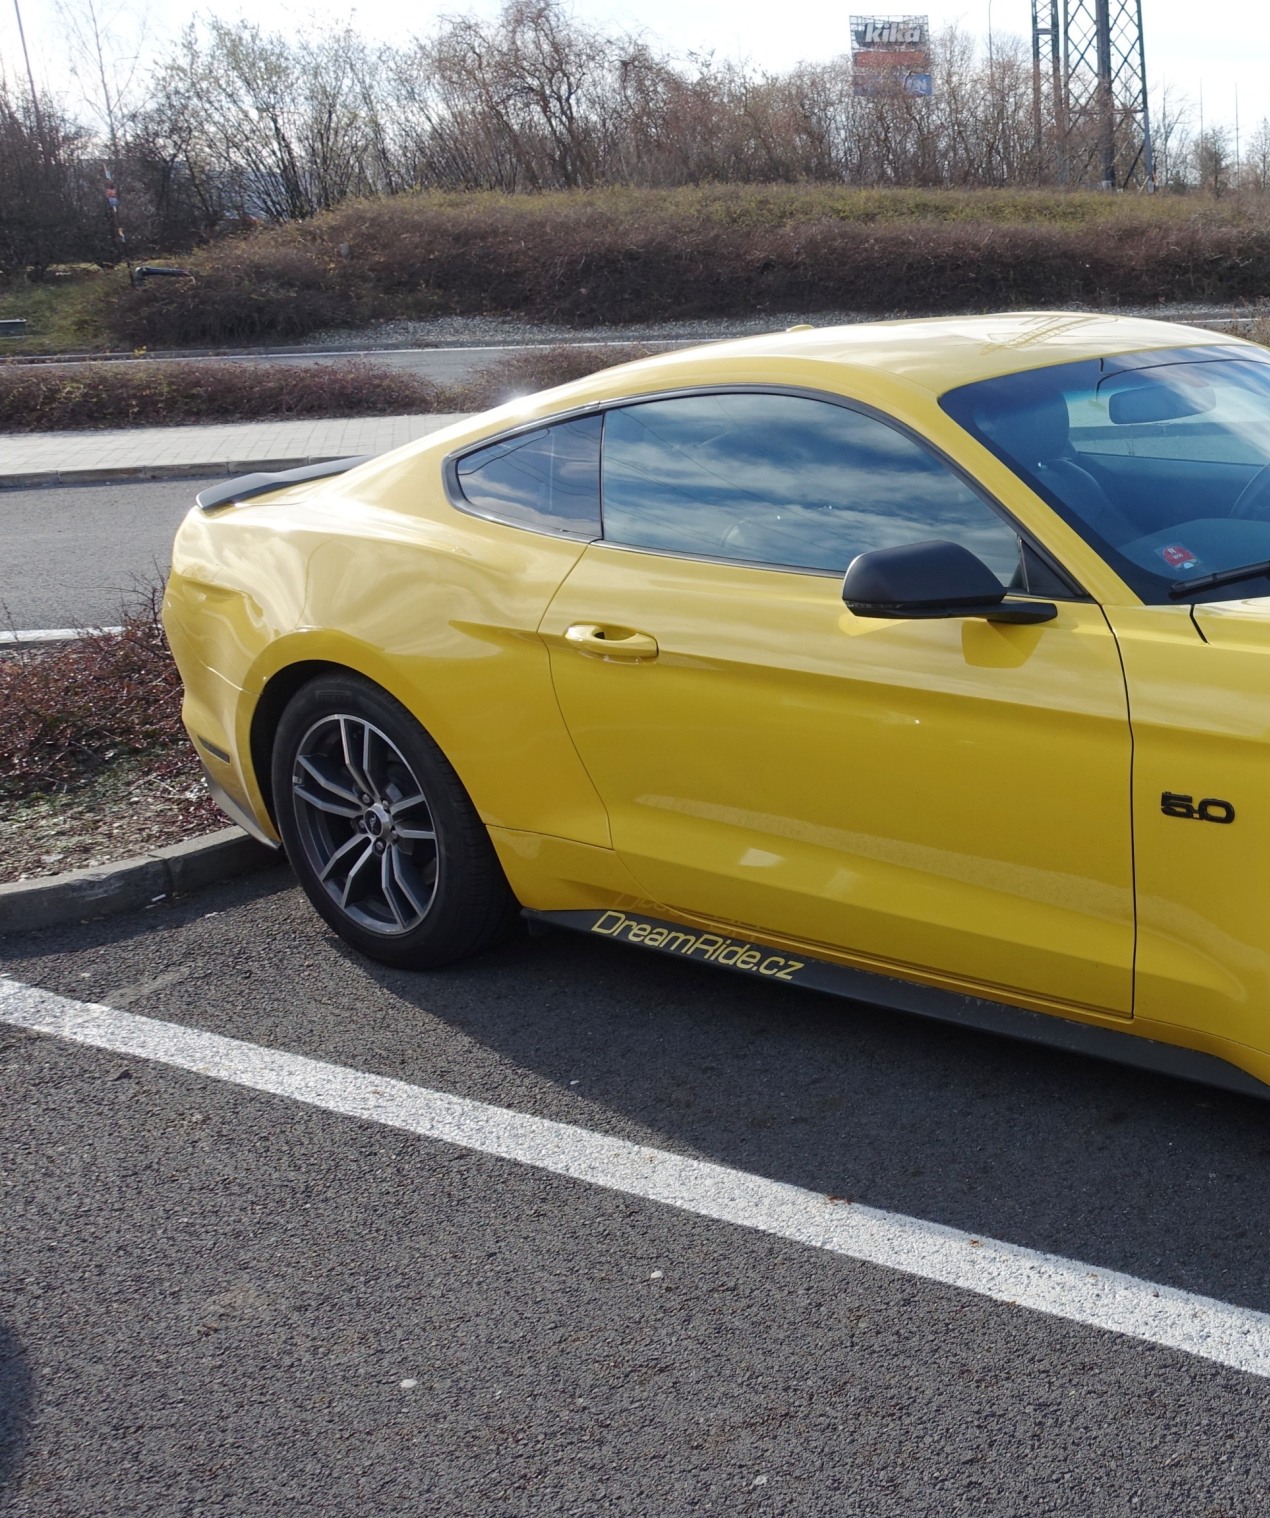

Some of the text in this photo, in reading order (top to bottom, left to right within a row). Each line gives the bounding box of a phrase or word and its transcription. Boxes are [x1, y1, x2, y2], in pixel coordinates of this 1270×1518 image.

[865, 22, 921, 42] kika
[1161, 791, 1235, 824] 5.0
[591, 910, 804, 980] DreamRide.cz
